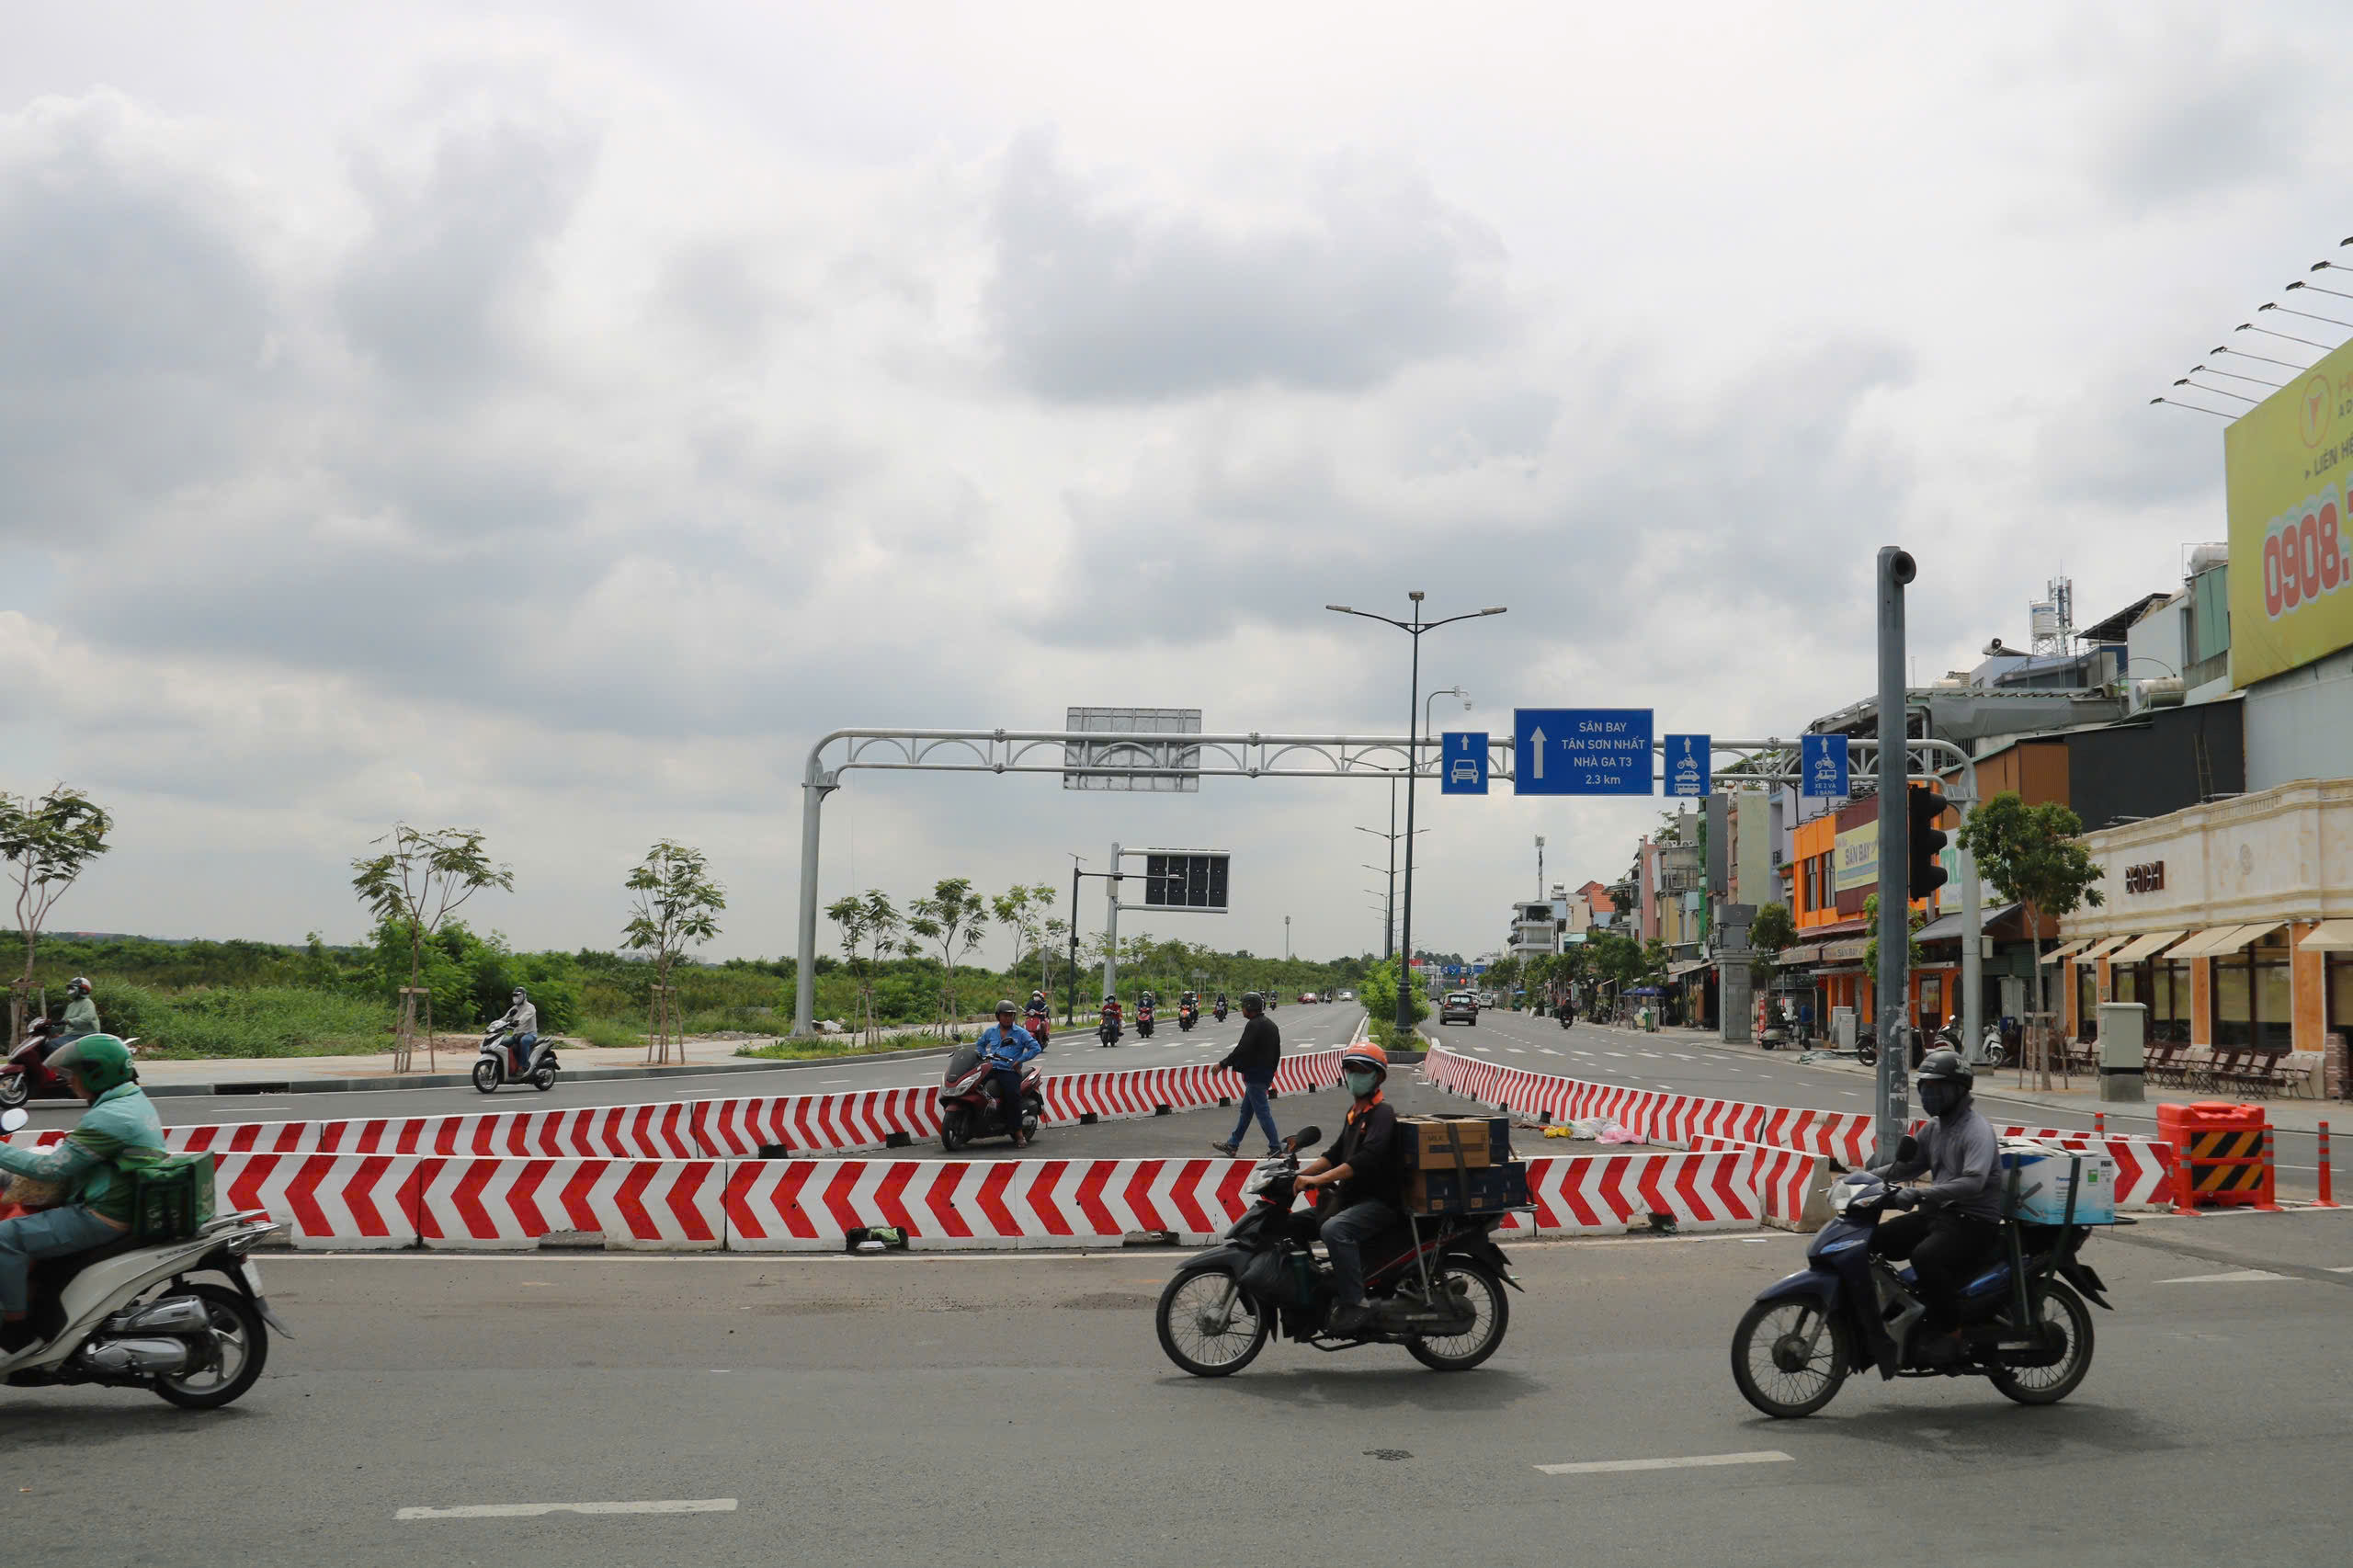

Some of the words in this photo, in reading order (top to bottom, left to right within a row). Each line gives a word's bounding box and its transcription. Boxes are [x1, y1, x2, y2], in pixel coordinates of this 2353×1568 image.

[2264, 490, 2353, 618] 0908.
[1579, 721, 1602, 733] SÂN
[1606, 722, 1627, 733] BAY
[1562, 737, 1585, 749] TÂN
[1587, 739, 1611, 749] SƠN
[1614, 735, 1645, 749] NHẤT
[1574, 755, 1598, 767] NHÀ
[1601, 757, 1616, 767] GA
[1619, 757, 1632, 767] T3
[1586, 775, 1601, 785] 2.3
[1604, 775, 1620, 785] km
